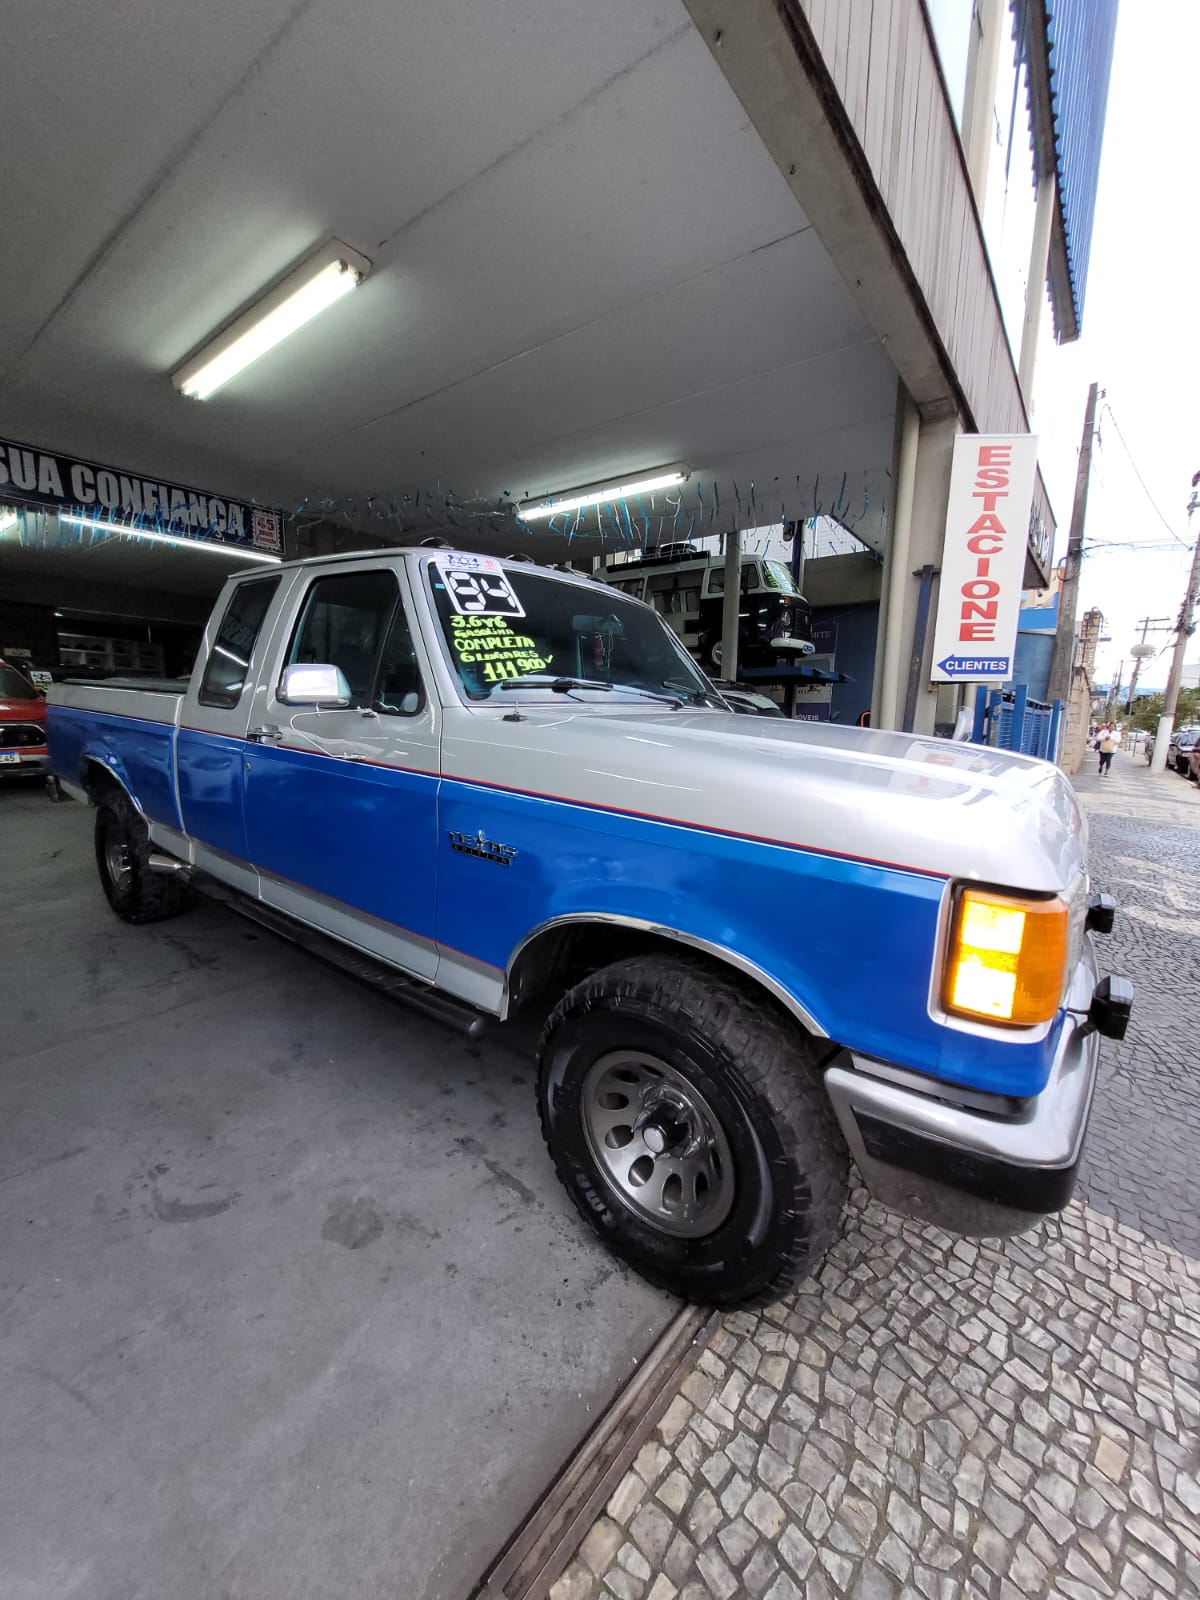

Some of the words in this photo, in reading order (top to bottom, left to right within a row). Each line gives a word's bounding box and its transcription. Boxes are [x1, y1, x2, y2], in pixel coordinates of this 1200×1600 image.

[71, 464, 246, 538] CONFIANÇA
[959, 446, 1012, 642] ESTACIONE
[450, 571, 516, 611] 94
[454, 636, 535, 651] COMPLETA
[460, 652, 475, 663] 6
[945, 660, 1007, 671] CLIENTES
